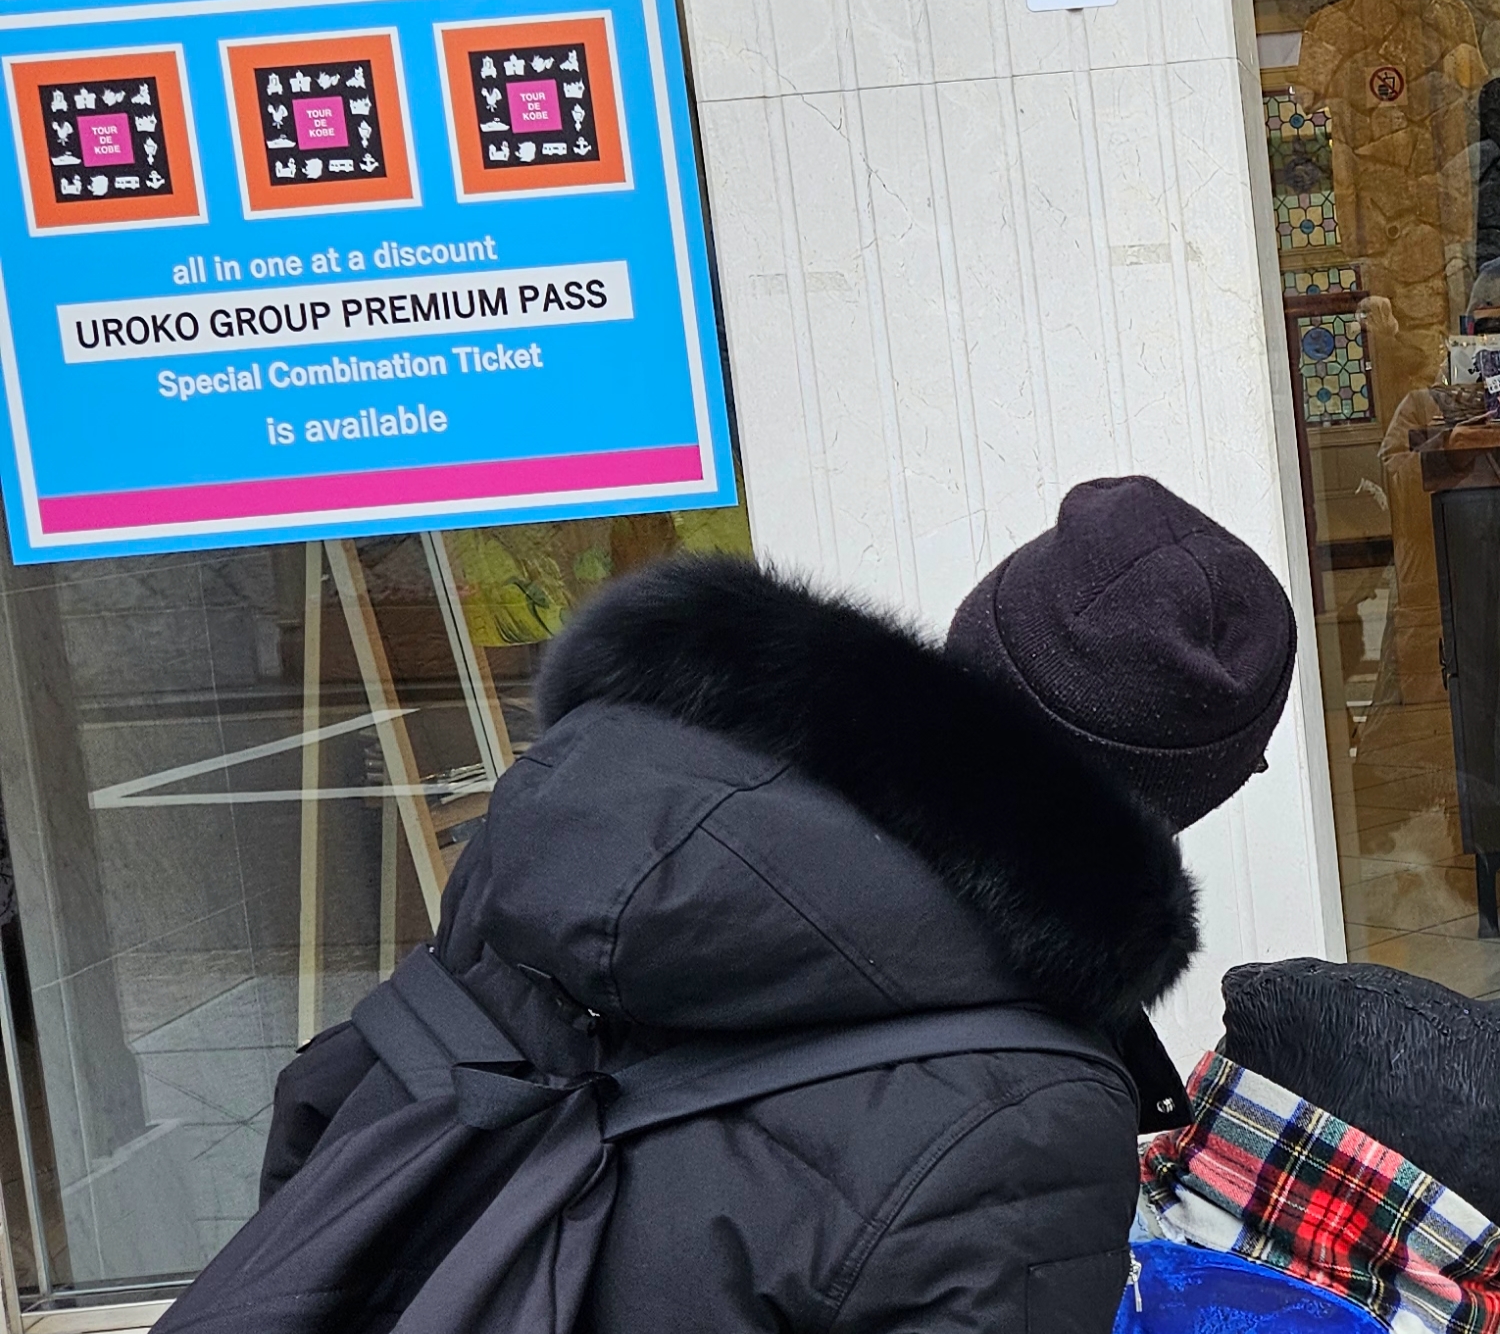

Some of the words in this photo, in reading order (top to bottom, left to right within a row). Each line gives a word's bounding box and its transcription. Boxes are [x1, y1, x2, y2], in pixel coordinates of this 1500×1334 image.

[519, 91, 546, 104] TOUR
[527, 101, 541, 112] DE
[306, 108, 333, 121] TOUR
[521, 109, 549, 122] KOBE
[313, 118, 327, 129] DE
[91, 125, 118, 138] TOUR
[308, 126, 336, 139] KOBE
[99, 135, 113, 145] DE
[93, 142, 122, 156] KOBE
[172, 257, 206, 285] all
[214, 255, 241, 282] in
[250, 253, 303, 280] one
[312, 247, 341, 274] at
[347, 249, 366, 273] a
[372, 234, 499, 269] discount
[76, 311, 199, 350] UROKO
[209, 301, 331, 341] GROUP
[343, 287, 509, 329] PREMIUM
[518, 279, 608, 314] PASS
[157, 362, 261, 402] Special
[268, 351, 447, 390] Combination
[452, 343, 543, 376] Ticket
[267, 416, 295, 446] is
[304, 403, 448, 444] available
